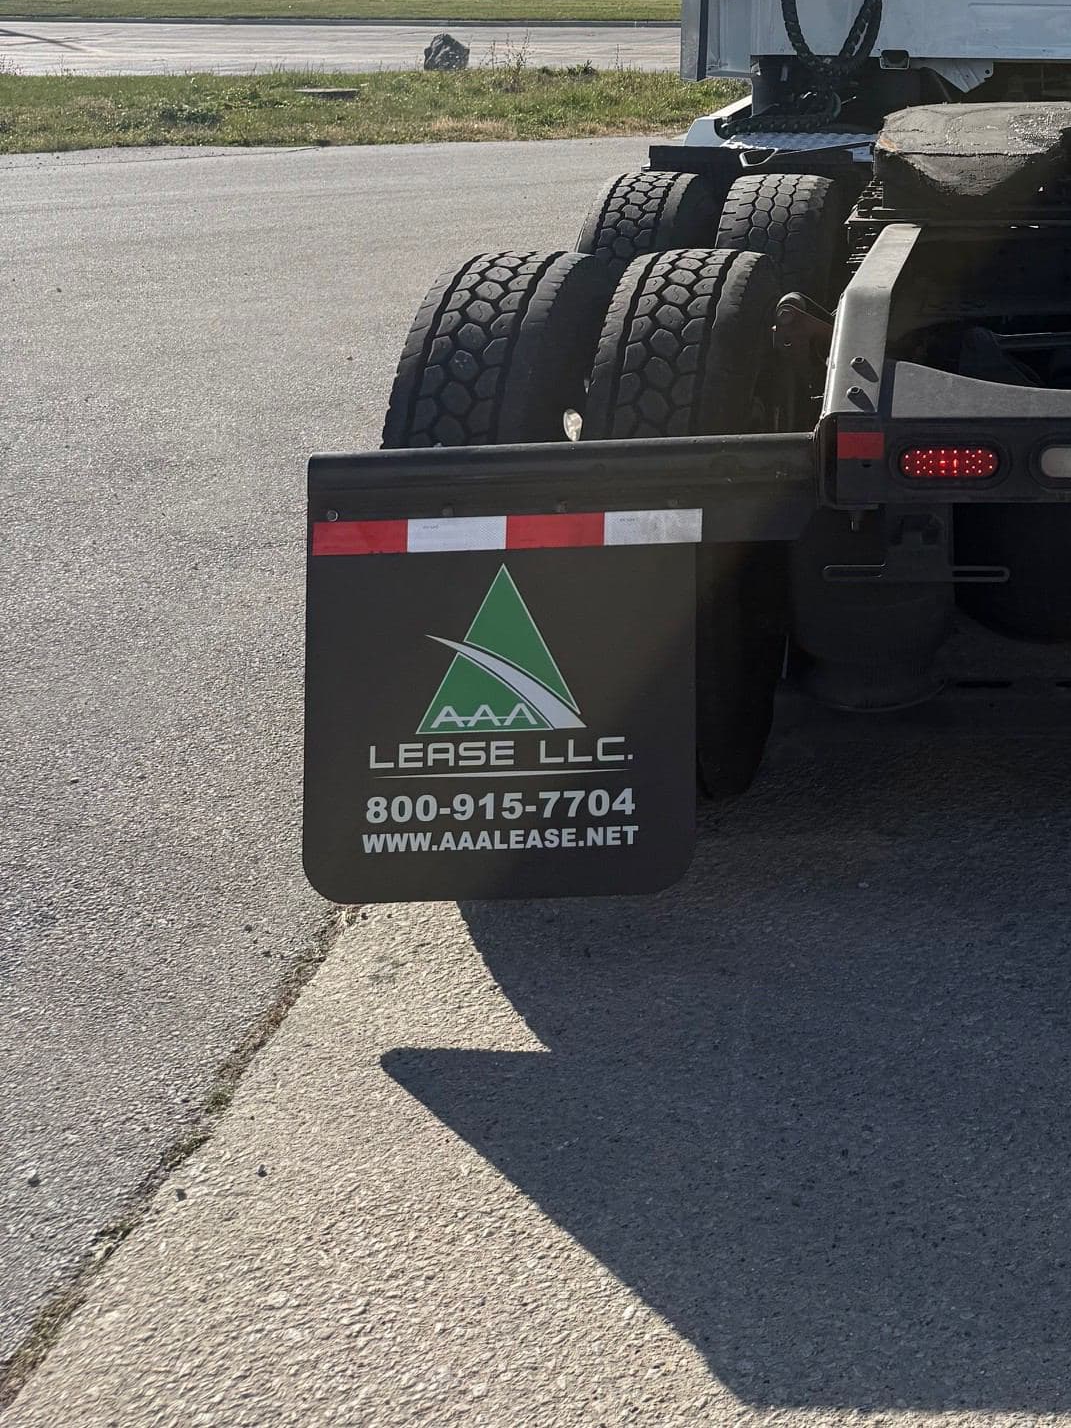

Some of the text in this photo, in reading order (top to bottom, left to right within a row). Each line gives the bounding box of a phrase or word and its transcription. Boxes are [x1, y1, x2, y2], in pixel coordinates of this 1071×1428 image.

[430, 702, 539, 729] AAA
[369, 736, 634, 770] LEASE LLC.
[366, 788, 636, 824] 800-915-7704
[362, 825, 640, 854] WWW.AAALEASE.NET
